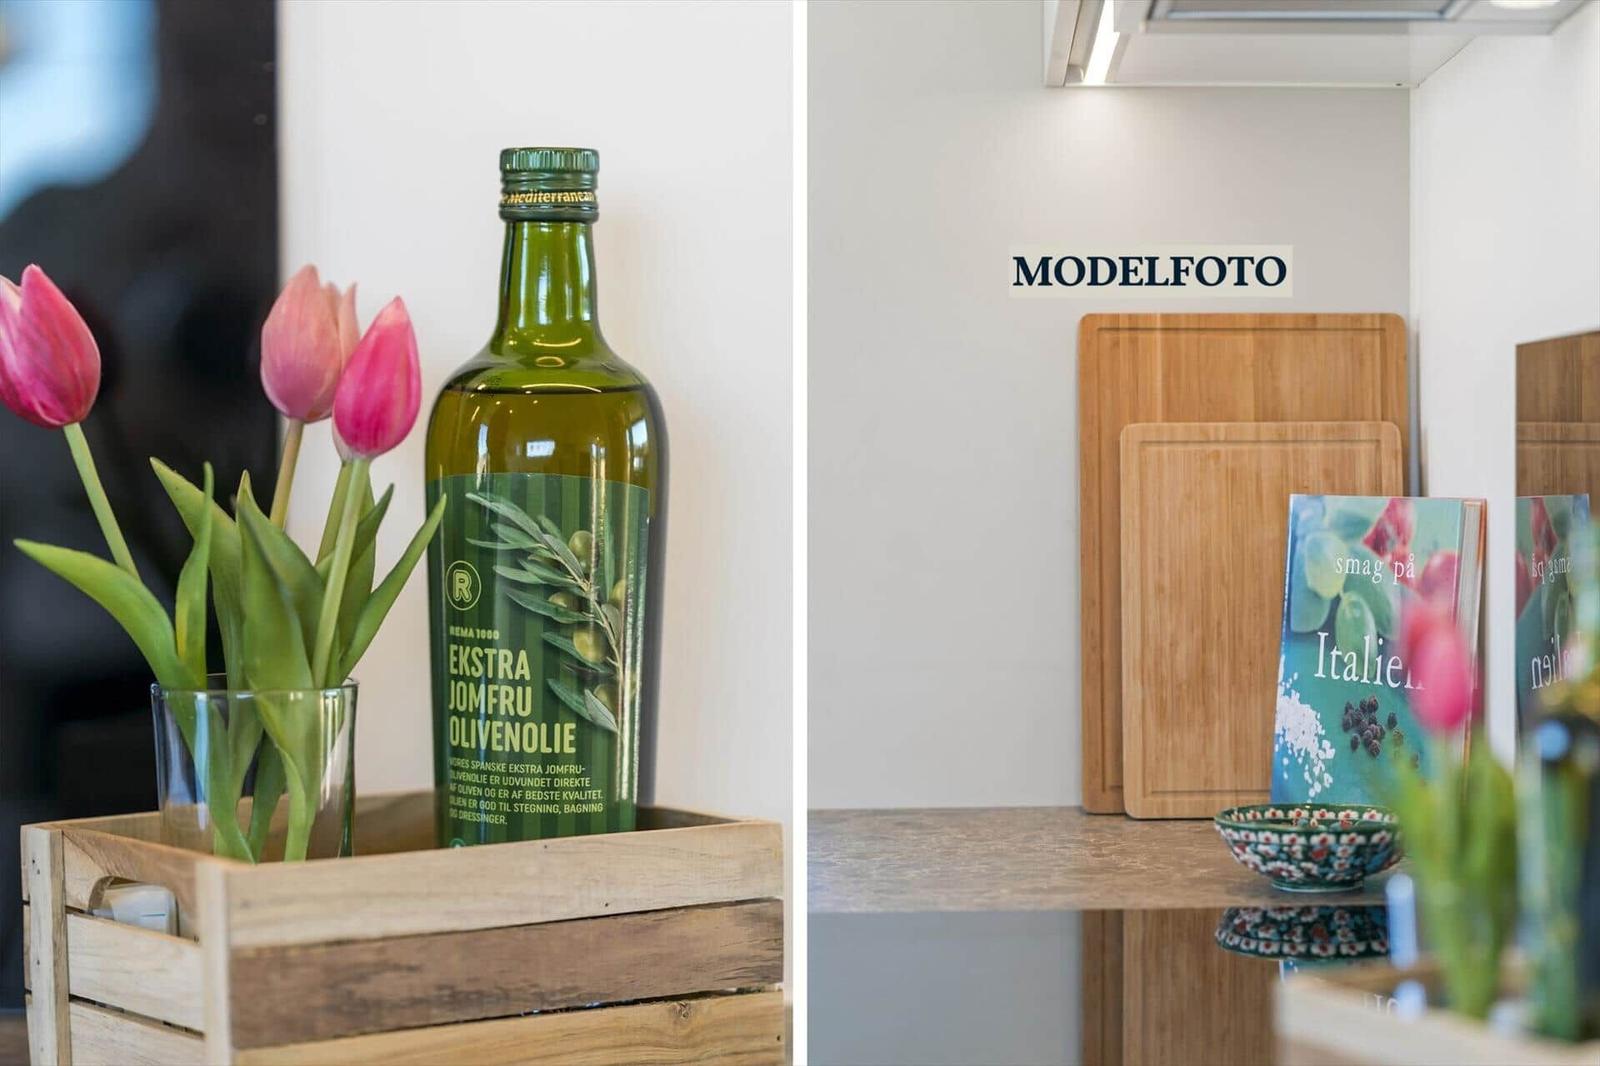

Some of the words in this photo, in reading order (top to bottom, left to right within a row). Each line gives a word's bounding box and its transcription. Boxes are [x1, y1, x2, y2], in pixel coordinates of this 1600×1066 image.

[1335, 556, 1384, 584] smag
[1393, 553, 1416, 585] på
[449, 625, 475, 639] REMA
[476, 628, 500, 640] 1000
[449, 643, 532, 681] EKSTRA
[448, 679, 532, 718] JOMFRU
[449, 716, 577, 754] OLIVENOLIE
[470, 760, 507, 773] SPANSKE
[508, 763, 543, 774] EKSTRA
[544, 764, 586, 775] JOMFRU-
[489, 775, 500, 785] ER
[502, 776, 551, 787] UDVUNDET
[553, 777, 591, 788] DIREKTE
[457, 784, 483, 797] OLIVEN
[484, 788, 496, 798] OG
[498, 789, 510, 799] ER
[511, 790, 523, 799] AF
[525, 790, 561, 801] BEDSTE
[562, 789, 604, 801] KVALITET.
[468, 798, 478, 809] ER
[479, 800, 497, 811] GOD
[498, 802, 512, 812] TIL
[513, 803, 561, 815] STEGNING,
[563, 802, 604, 814] BAGNING
[458, 810, 508, 825] DRESSINGER.
